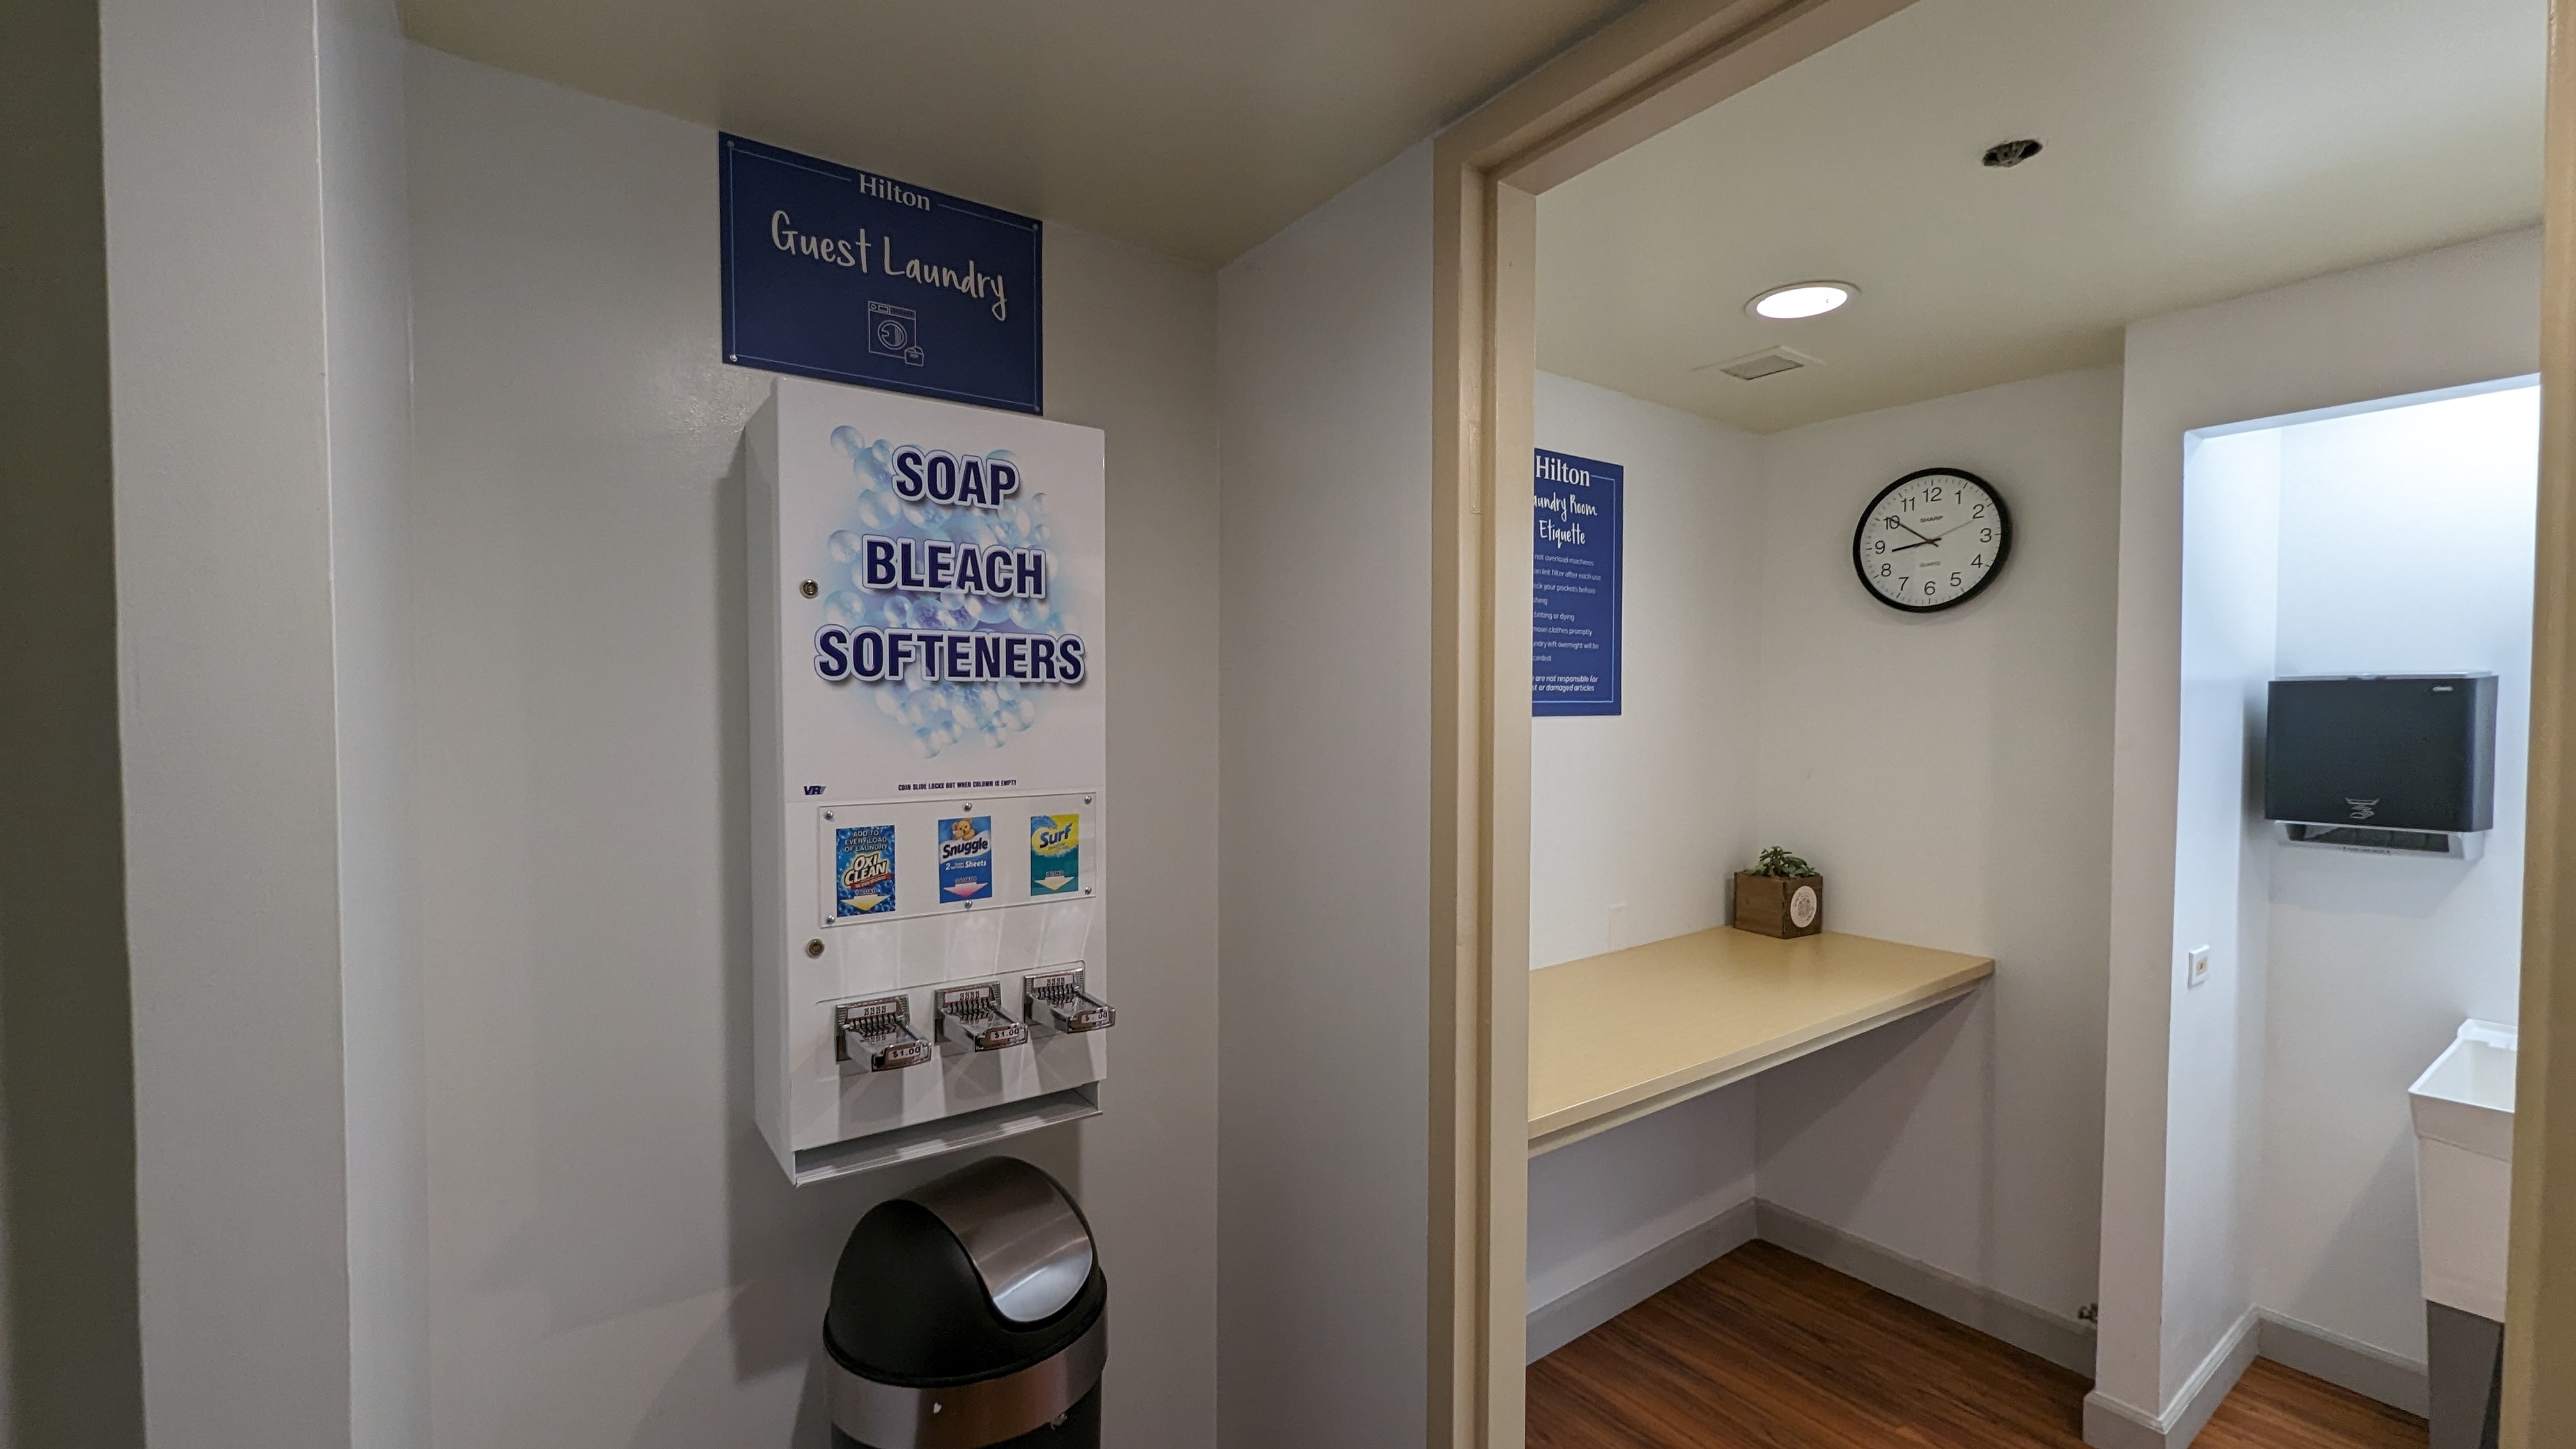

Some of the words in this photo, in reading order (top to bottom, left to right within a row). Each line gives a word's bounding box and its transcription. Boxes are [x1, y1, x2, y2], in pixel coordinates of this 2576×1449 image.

[859, 173, 931, 211] Hilton
[770, 210, 871, 273] Guest
[884, 236, 1008, 322] Laundry
[893, 448, 1018, 508] SOAP
[1535, 455, 1590, 487] Hilton
[1922, 487, 1942, 503] 12
[1954, 489, 1961, 505] 1
[1570, 494, 1597, 516] Room
[1901, 496, 1915, 512] 11
[1972, 504, 1984, 519] 2
[1884, 515, 1900, 530] 10
[1538, 518, 1586, 549] Etiquette
[1980, 528, 1992, 542] 3
[1875, 540, 1885, 555] 9
[864, 537, 1048, 599] BLEACH
[1970, 554, 1983, 568] 4
[1565, 571, 1578, 579] after
[1881, 563, 1892, 577] 8
[1899, 576, 1909, 591] 7
[1950, 572, 1961, 586] 5
[1556, 584, 1578, 592] pockets
[1924, 581, 1936, 595] 6
[1560, 613, 1575, 622] dying
[816, 627, 1084, 682] SOFTENERS
[1545, 684, 1574, 693] damaged
[1039, 823, 1072, 848] Surf
[942, 837, 988, 859] Snuggle
[854, 854, 878, 870] OXI
[965, 860, 986, 868] Sheets
[844, 861, 887, 886] CLEAN
[994, 1028, 1019, 1039] $1.00
[893, 1046, 921, 1058] $1.00
